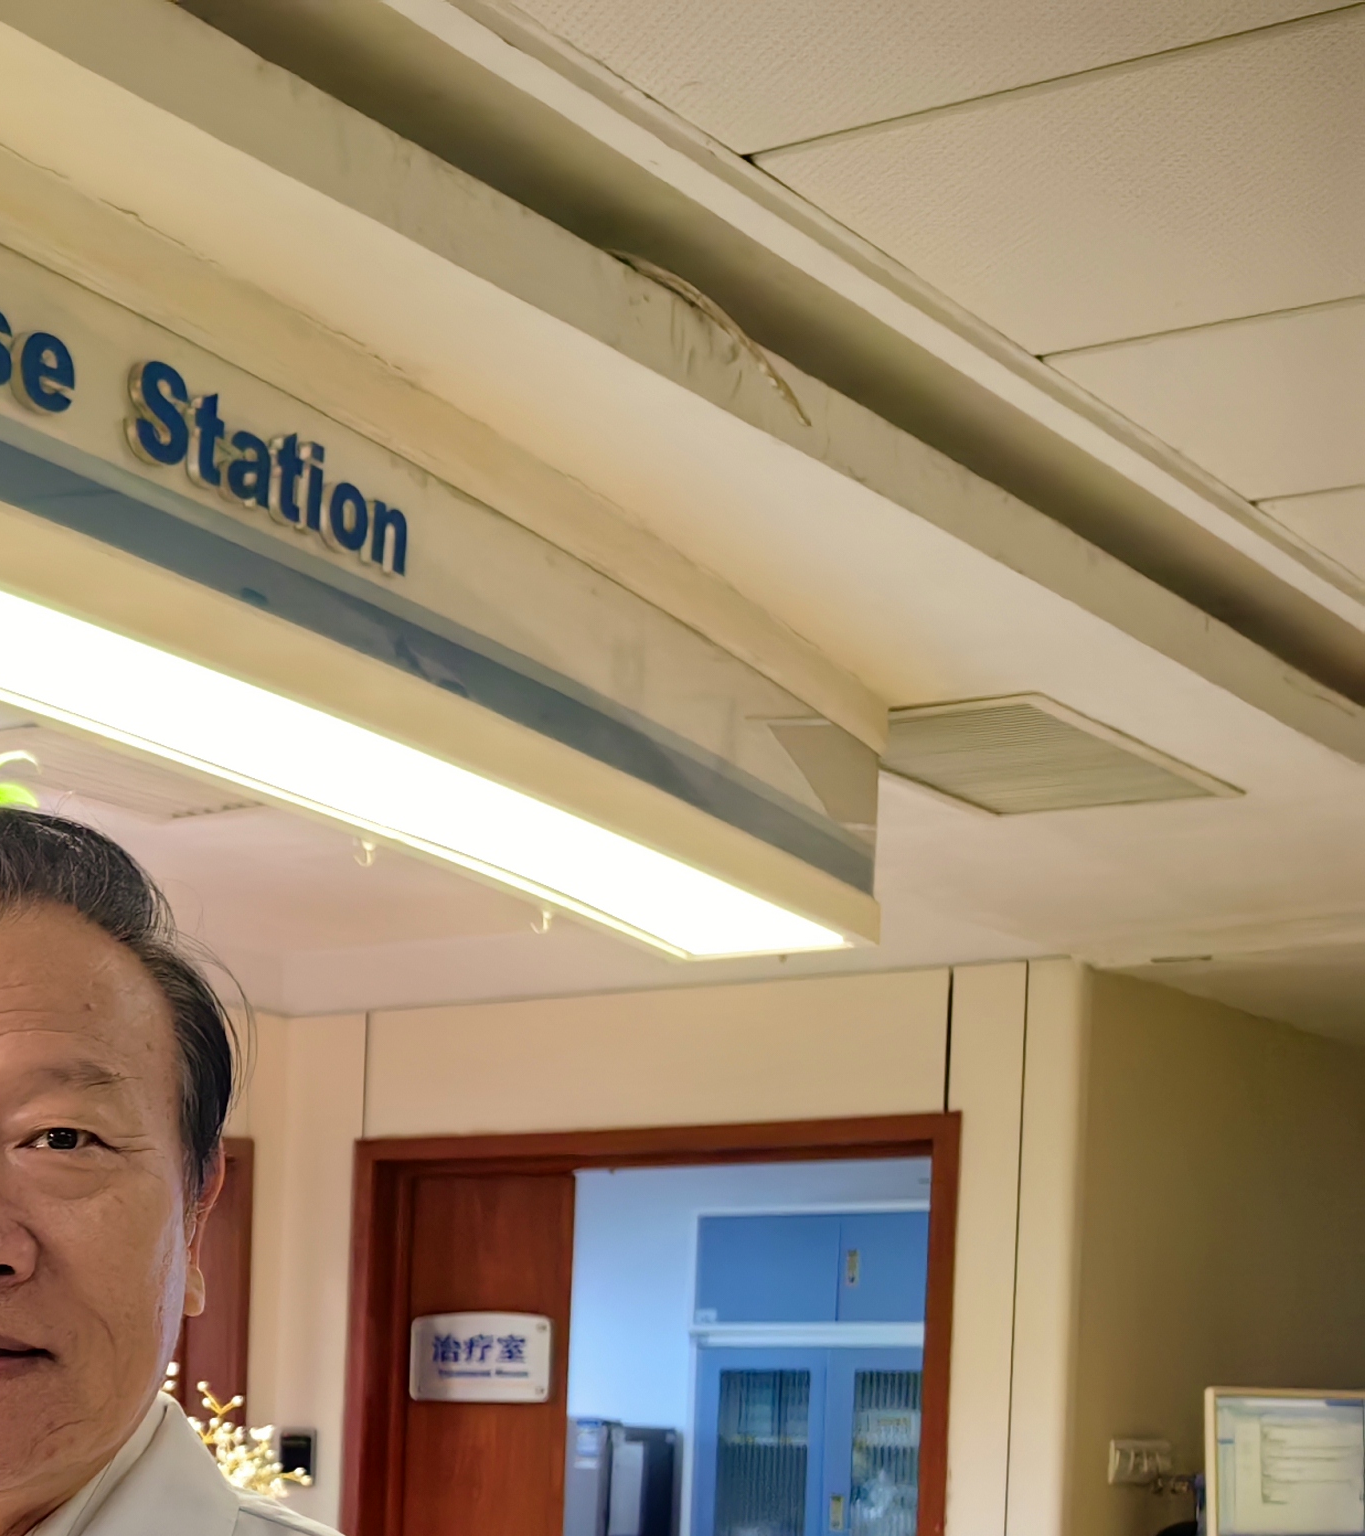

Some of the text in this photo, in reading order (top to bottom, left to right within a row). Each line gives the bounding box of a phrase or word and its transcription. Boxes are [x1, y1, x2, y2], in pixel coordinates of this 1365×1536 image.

[126, 361, 407, 576] Station
[432, 1334, 526, 1363] 治疗室
